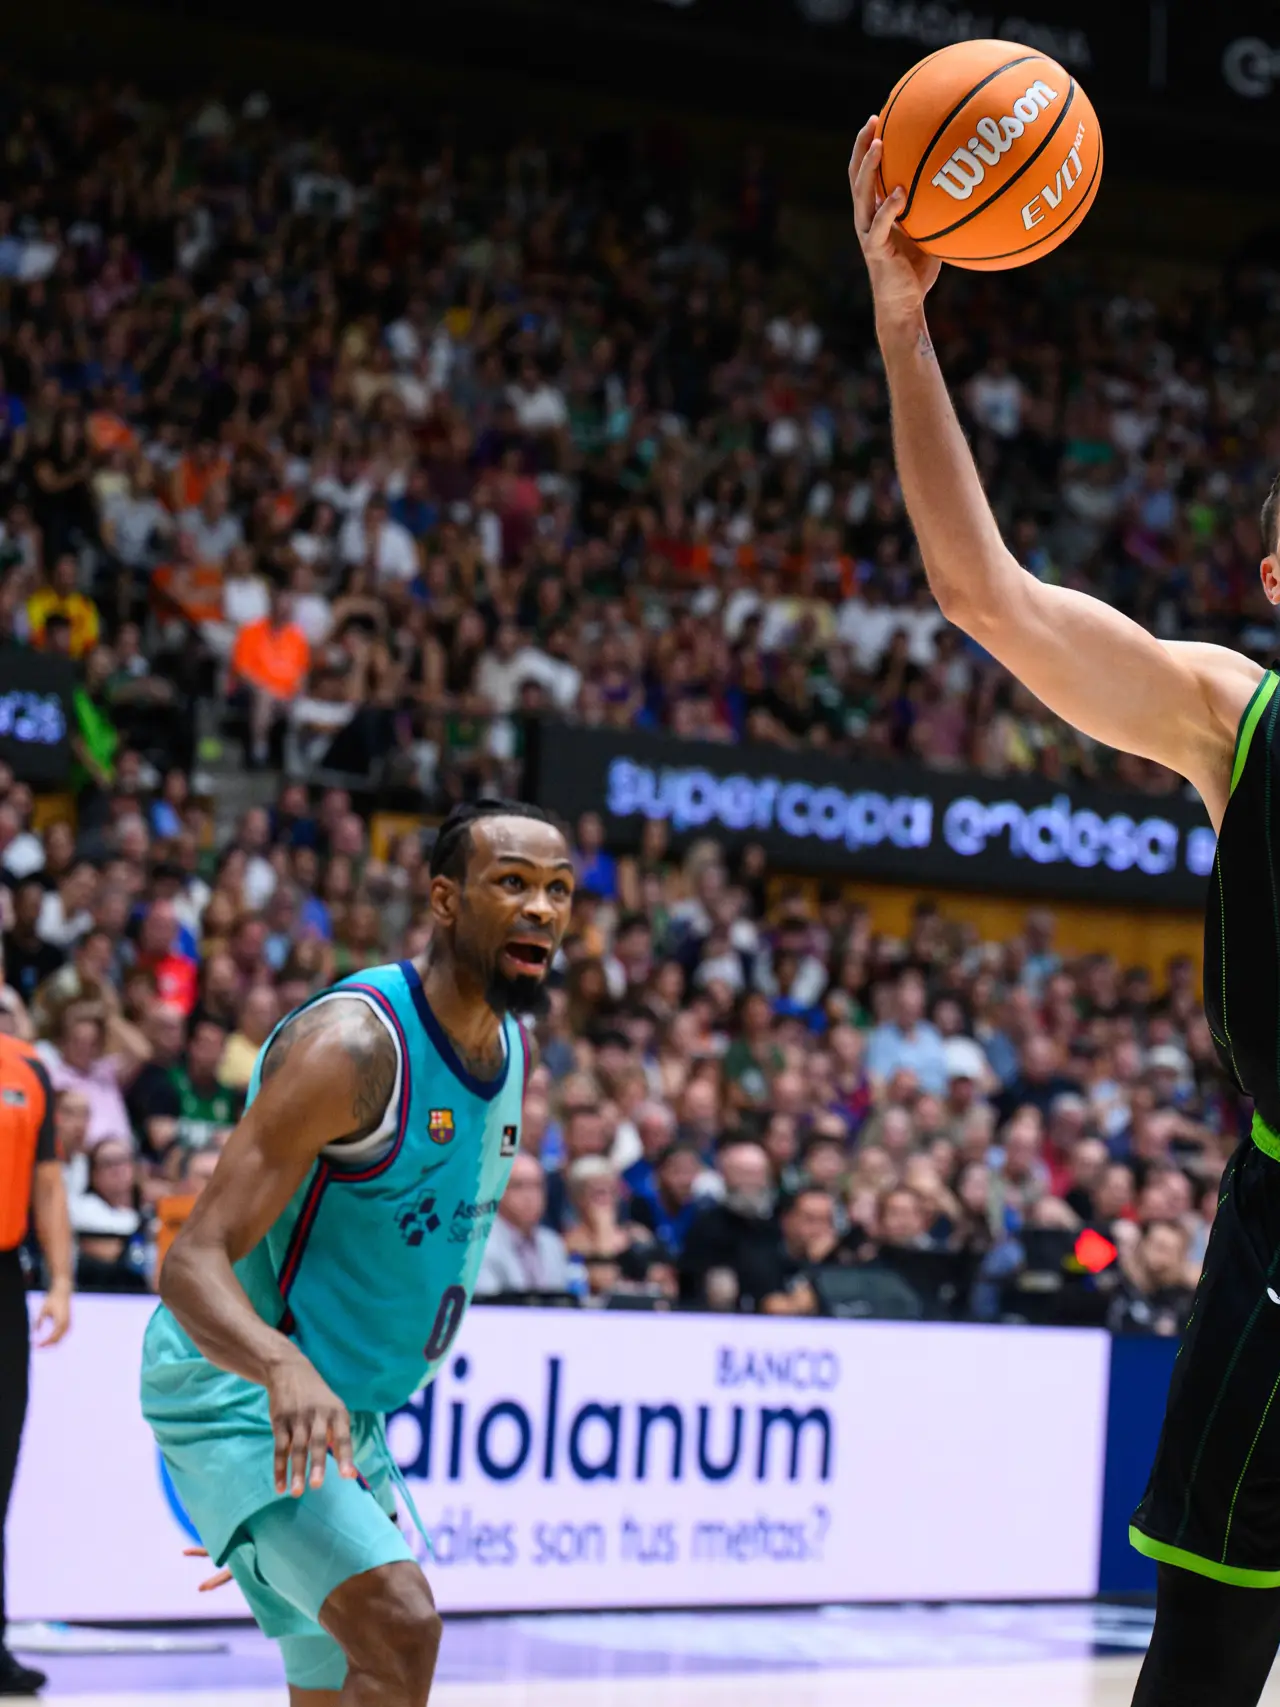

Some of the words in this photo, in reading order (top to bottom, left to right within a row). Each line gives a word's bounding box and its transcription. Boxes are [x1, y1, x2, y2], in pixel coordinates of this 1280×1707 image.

[931, 79, 1058, 201] Wilson
[1021, 147, 1083, 231] EVO
[608, 757, 932, 851] supercopa
[944, 793, 1178, 875] endesa
[423, 1285, 467, 1361] 0
[715, 1348, 840, 1391] BANCO
[533, 1520, 604, 1567] son
[621, 1508, 678, 1564] tus
[693, 1508, 832, 1565] metas?
